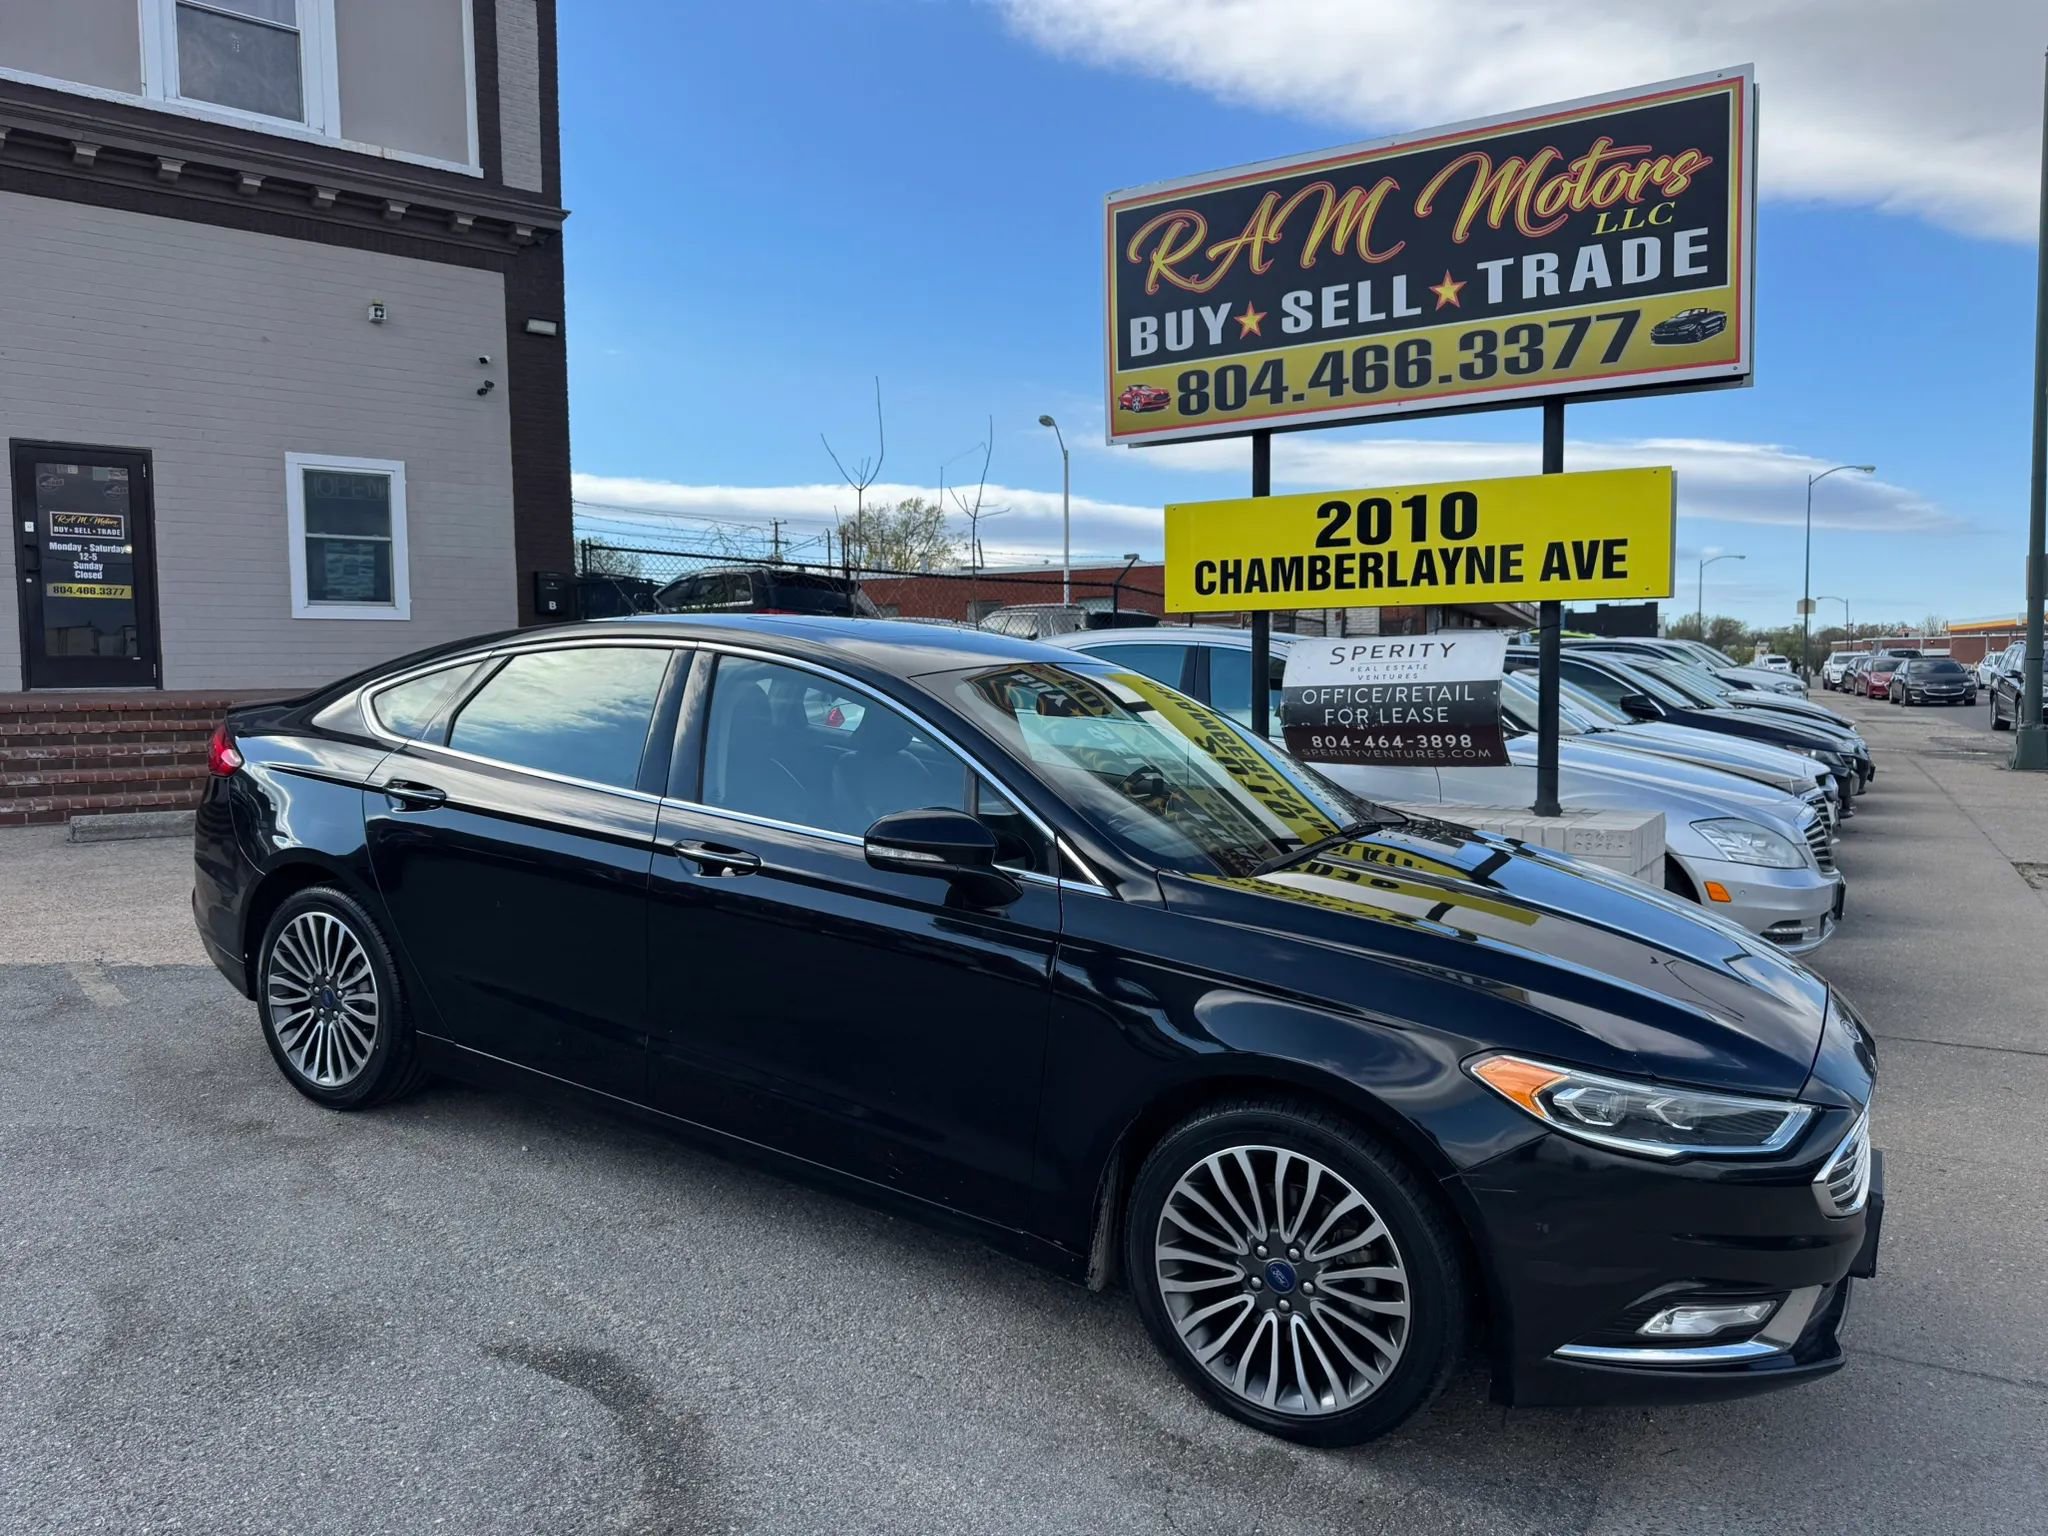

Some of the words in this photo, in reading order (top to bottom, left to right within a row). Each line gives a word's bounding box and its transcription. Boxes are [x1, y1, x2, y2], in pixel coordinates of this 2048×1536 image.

[1127, 177, 1405, 296] RAM
[1415, 136, 1712, 242] Motors
[1592, 201, 1676, 235] LLC
[1130, 302, 1233, 357] BUY
[1281, 274, 1422, 336] SELL
[1477, 227, 1709, 304] TRADE
[1176, 309, 1642, 417] 804.466.3377
[1315, 490, 1479, 548] 2010
[74, 527, 92, 535] SELL
[97, 528, 121, 536] TRADE
[49, 541, 82, 551] Monday
[89, 543, 125, 554] Saturday
[79, 552, 98, 561] 12-5
[73, 561, 103, 571] Sunday
[1194, 543, 1525, 596] CHAMBERLAYNE
[1539, 538, 1629, 582] AVE
[74, 570, 103, 579] Closed
[549, 601, 557, 610] B
[1330, 642, 1457, 665] SPERITY
[1350, 665, 1378, 673] REAL
[1385, 664, 1429, 672] ESTATE
[1357, 673, 1419, 681] VENTURES
[1302, 685, 1475, 704] OFFICE/RETAIL
[1324, 708, 1368, 724] FOR
[1379, 707, 1449, 724] LEASE
[1311, 734, 1472, 748] 804-464-3898
[1302, 749, 1491, 760] SPERITYVENTURES.COM
